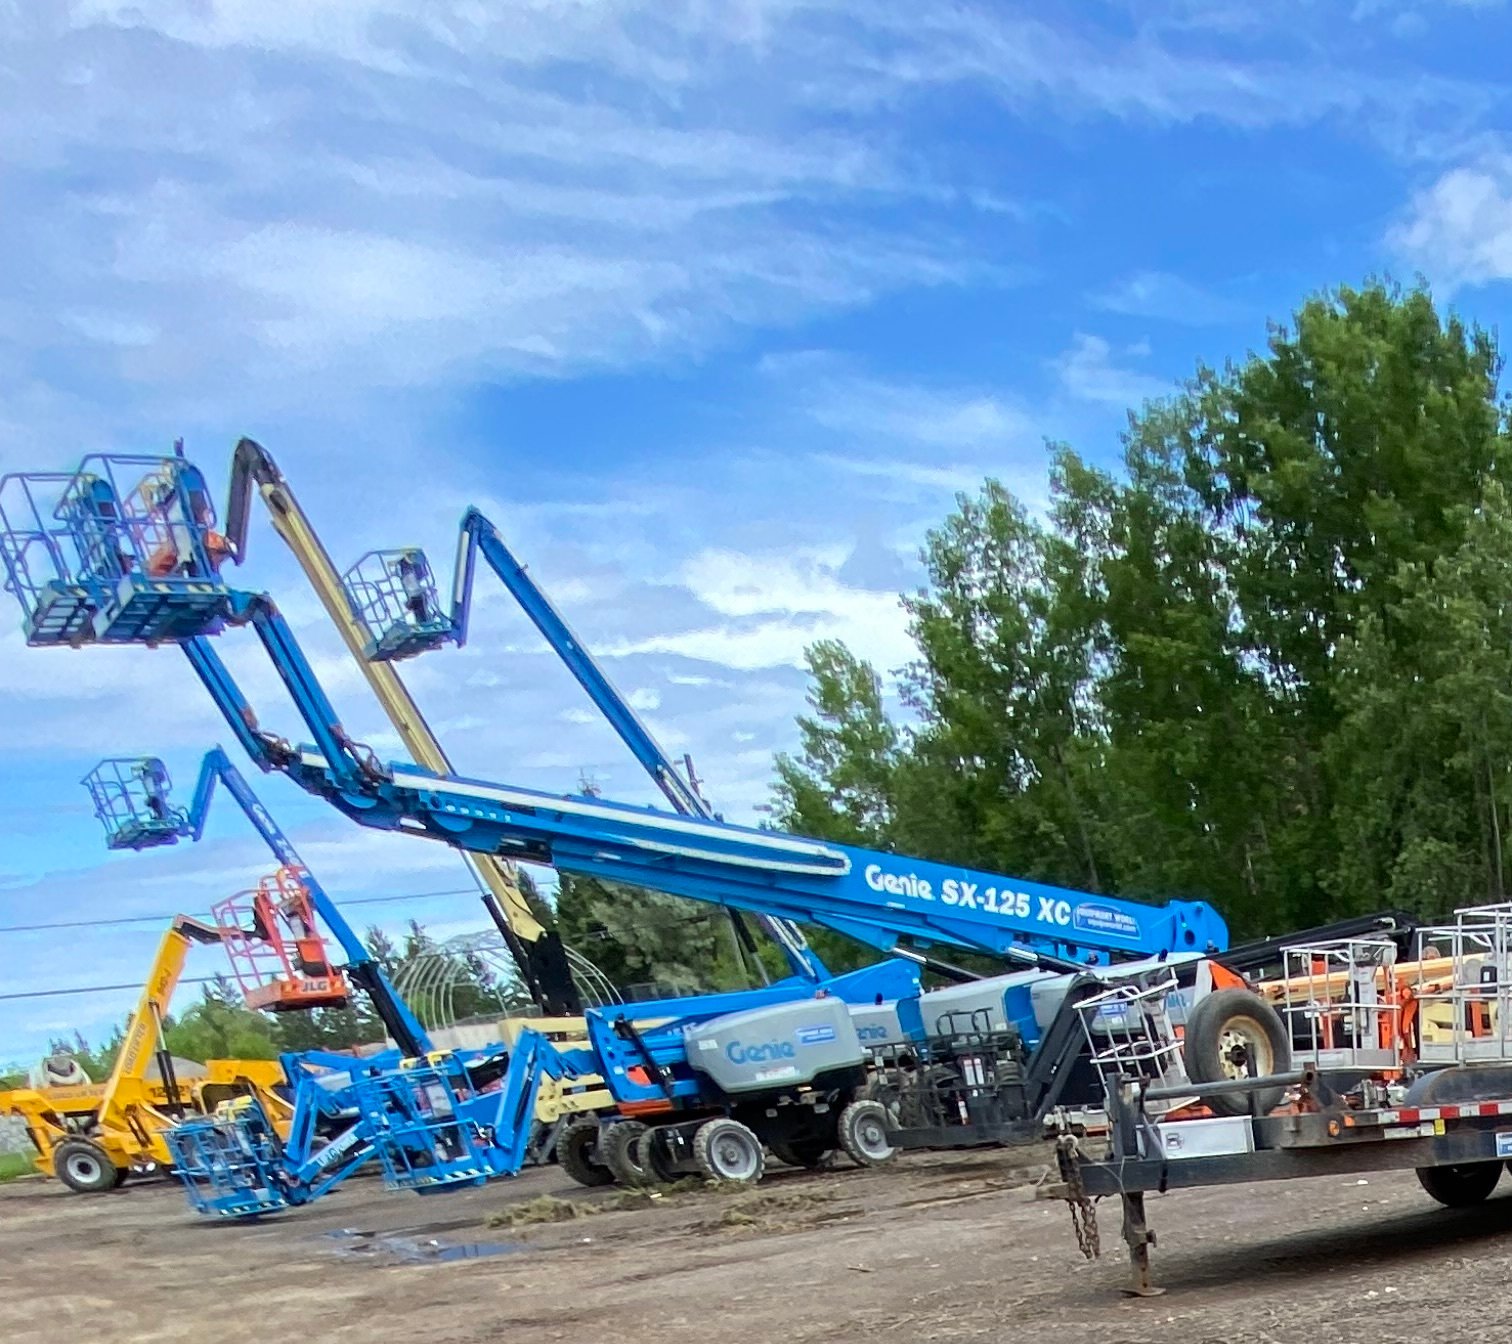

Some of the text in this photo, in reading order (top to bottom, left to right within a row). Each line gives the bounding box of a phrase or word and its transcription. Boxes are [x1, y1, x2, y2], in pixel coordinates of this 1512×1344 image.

[865, 863, 1071, 926] Genie SX-125 XC
[302, 981, 328, 992] JLG
[726, 1039, 796, 1065] Genie
